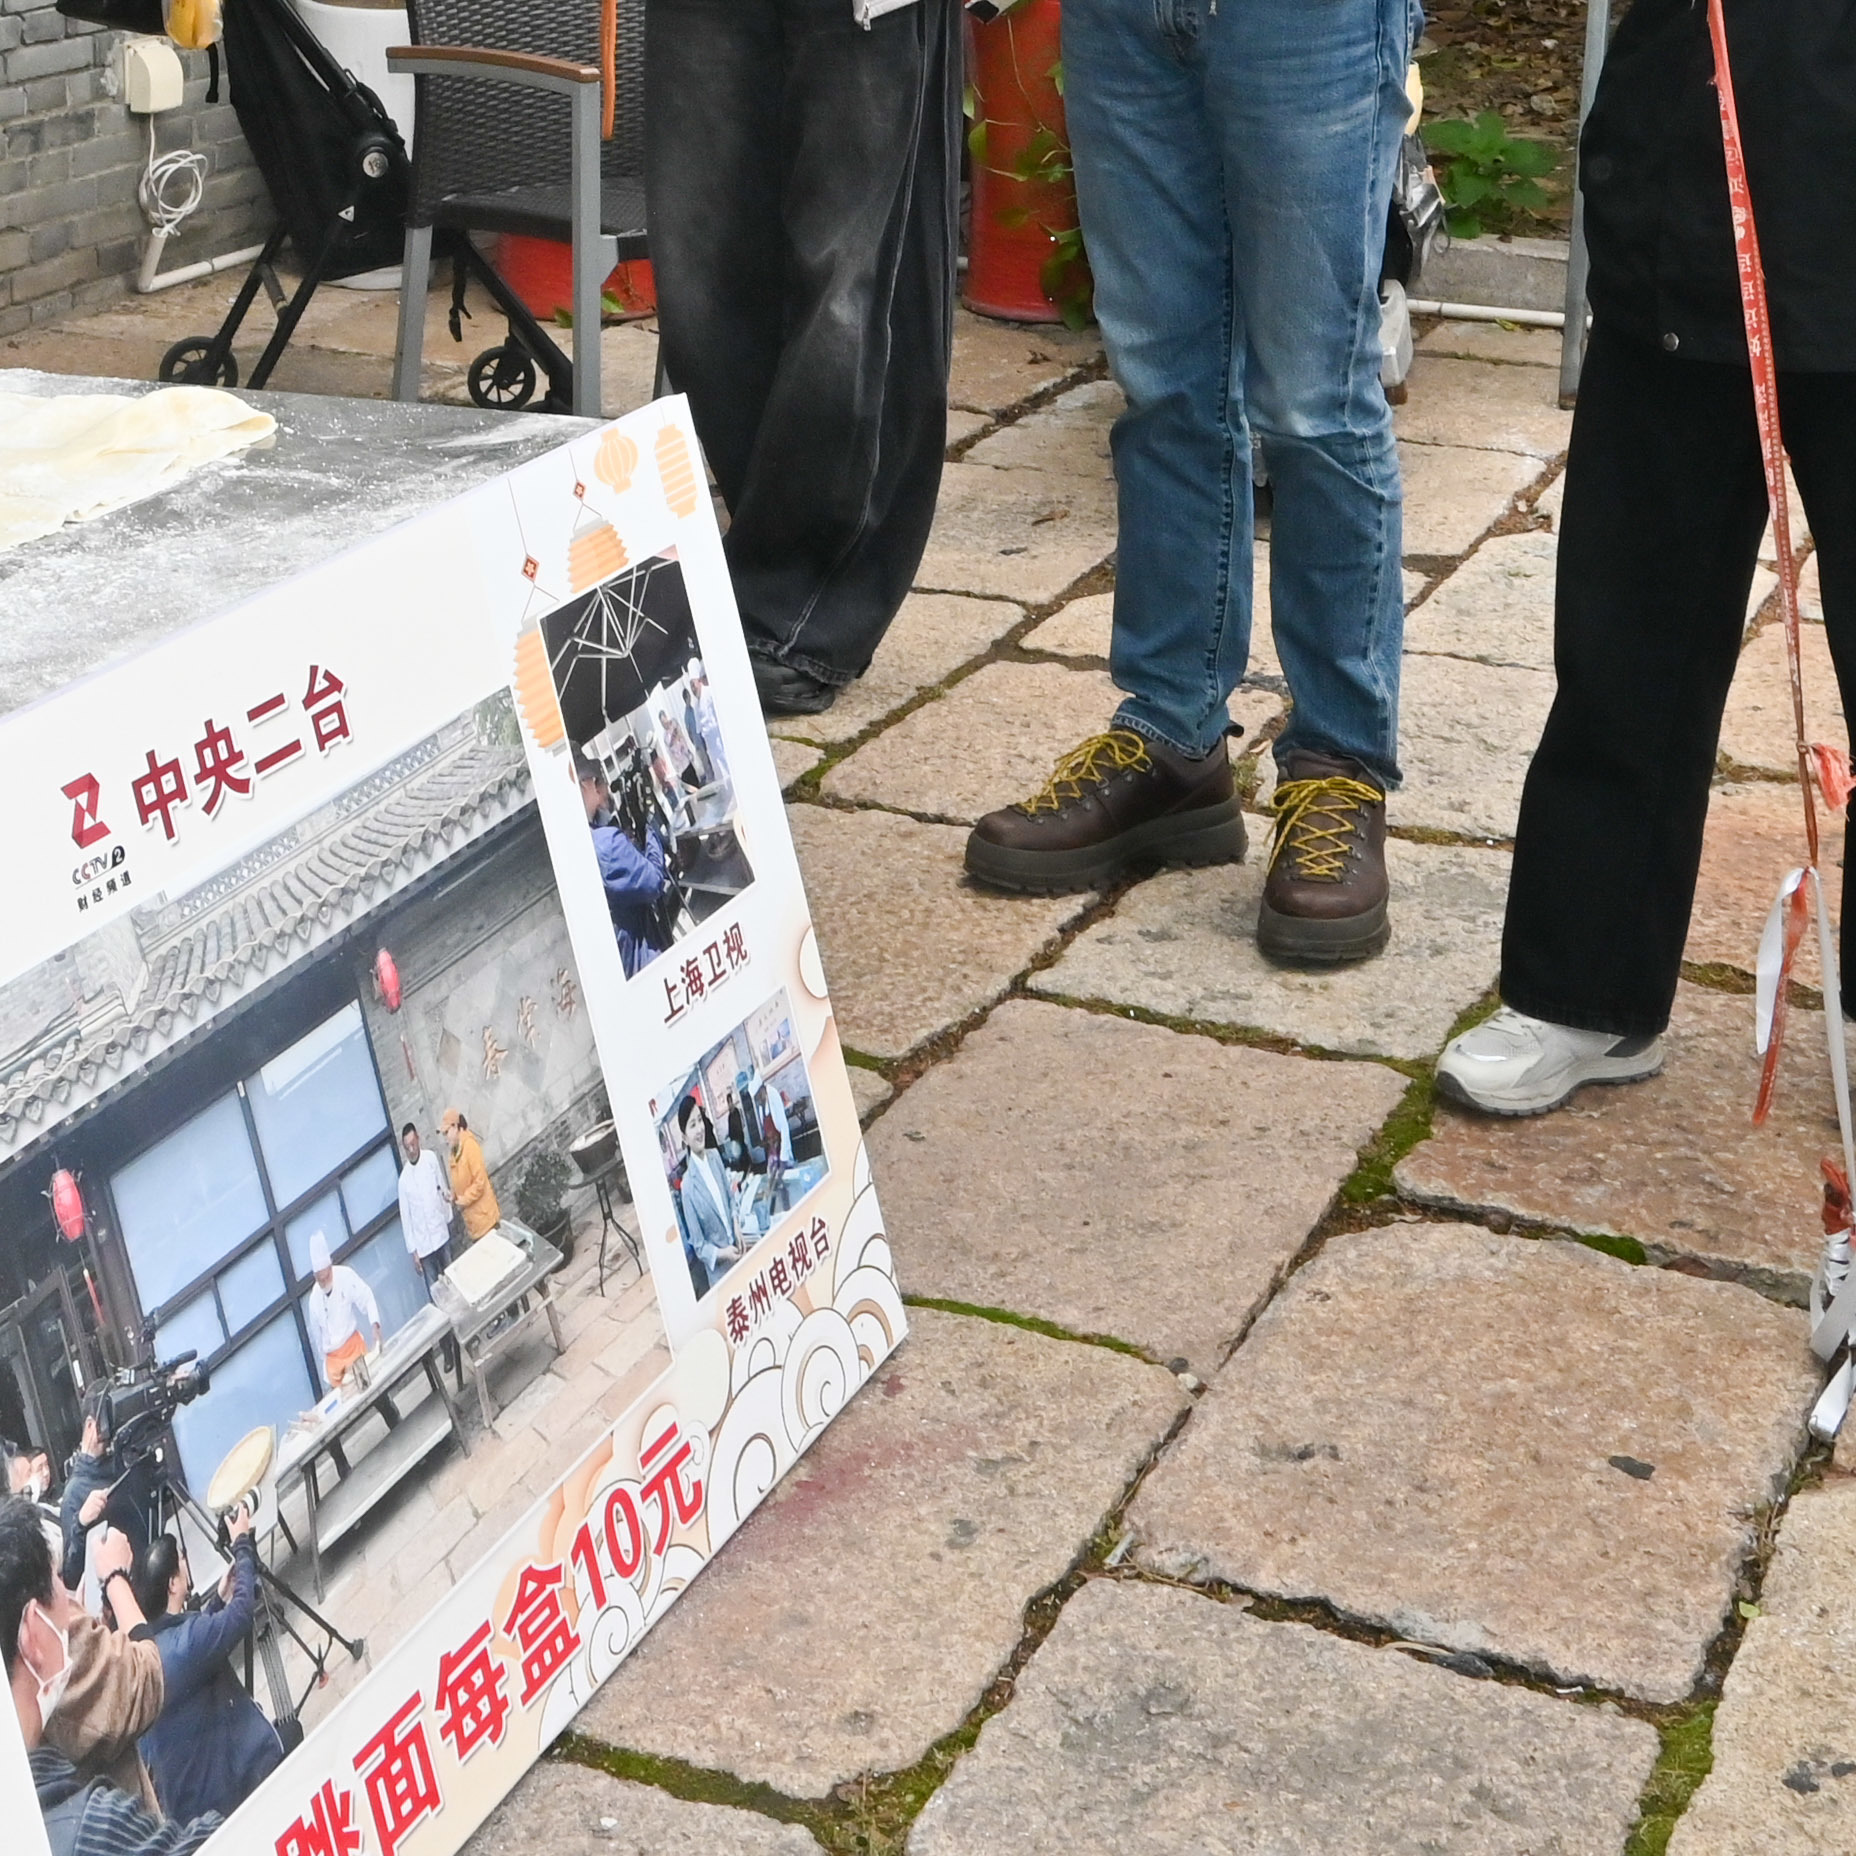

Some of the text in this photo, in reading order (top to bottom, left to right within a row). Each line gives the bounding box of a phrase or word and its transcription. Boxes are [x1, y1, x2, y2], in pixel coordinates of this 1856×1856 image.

[131, 664, 351, 841] 中央二台
[663, 921, 749, 1025] 上海卫视
[725, 1215, 832, 1342] 泰州电视台
